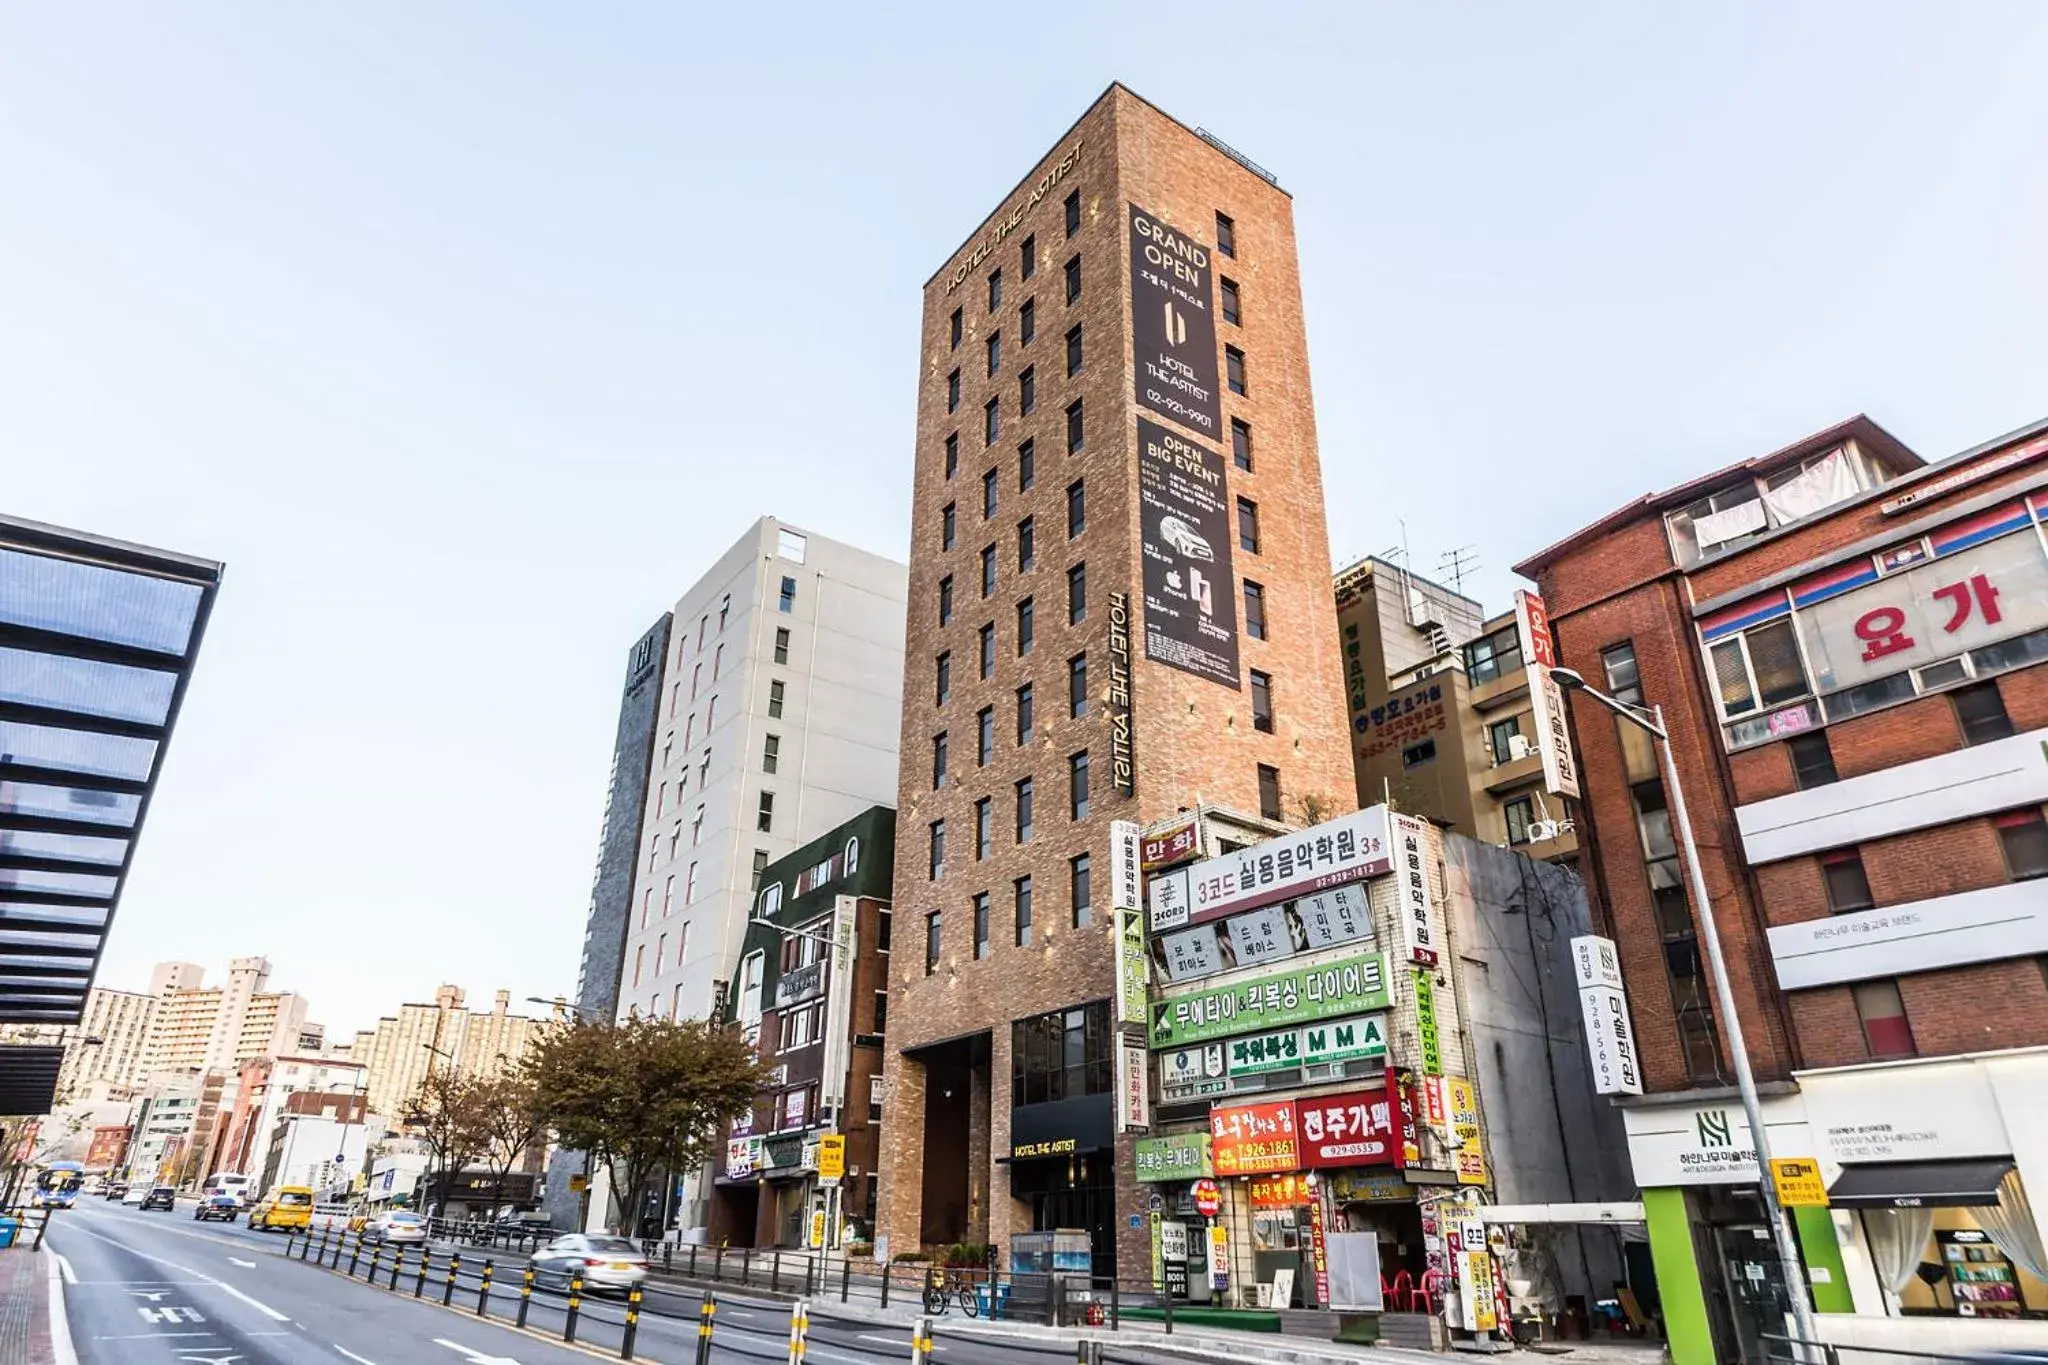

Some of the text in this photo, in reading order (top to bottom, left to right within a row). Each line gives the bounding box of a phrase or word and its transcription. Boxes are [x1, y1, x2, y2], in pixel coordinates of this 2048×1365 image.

[945, 241, 993, 296] HOTEL
[994, 203, 1024, 244] THE
[1134, 216, 1207, 269] GRAND
[1145, 245, 1198, 288] OPEN
[1146, 361, 1170, 383] THE
[1159, 353, 1198, 381] HOTEL
[1147, 441, 1172, 465] BIG
[1174, 454, 1221, 487] EVENT
[1164, 435, 1203, 464] OPEN
[1531, 610, 1552, 664] 요가
[1854, 573, 2003, 662] 요가
[1146, 830, 1194, 862] 만화
[1198, 873, 1236, 904] 3코드
[1239, 828, 1356, 891] 실용음악학원
[1233, 1032, 1298, 1064] 파워복싱
[1303, 1101, 1393, 1142] 전주가맥
[1015, 1144, 1037, 1157] HOTEL
[1037, 1142, 1051, 1154] THE
